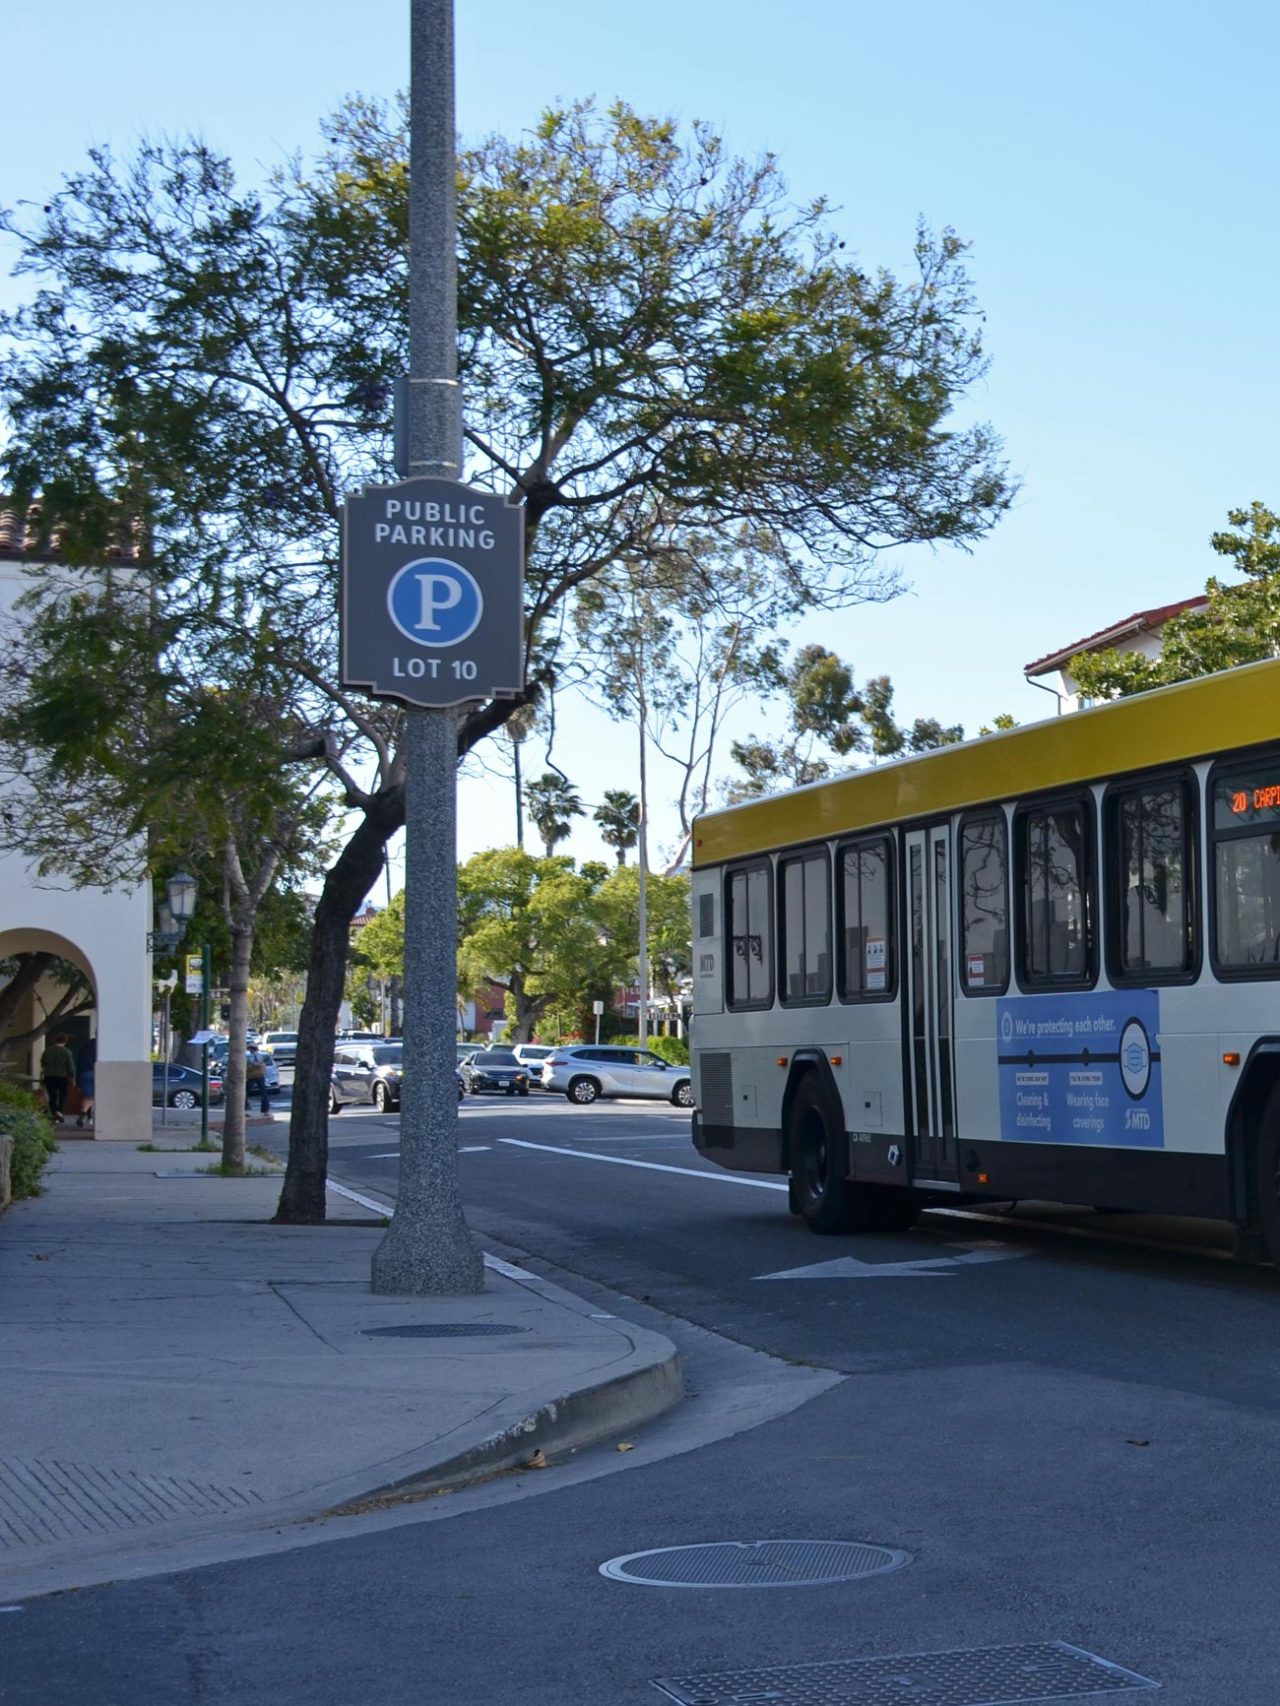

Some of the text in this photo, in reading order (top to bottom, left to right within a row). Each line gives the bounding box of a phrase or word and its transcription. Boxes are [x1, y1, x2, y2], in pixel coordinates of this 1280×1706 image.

[386, 499, 485, 525] PUBLIC
[375, 523, 495, 550] PARKING
[413, 573, 463, 631] P
[393, 657, 477, 680] LOT 10
[1232, 792, 1247, 812] 20
[1015, 1014, 1116, 1038] We're protecting each other.
[1016, 1091, 1049, 1109] Cleaning &
[1066, 1091, 1109, 1111] Wearing face
[1072, 1114, 1105, 1133] coverings
[1131, 1111, 1151, 1131] MTD
